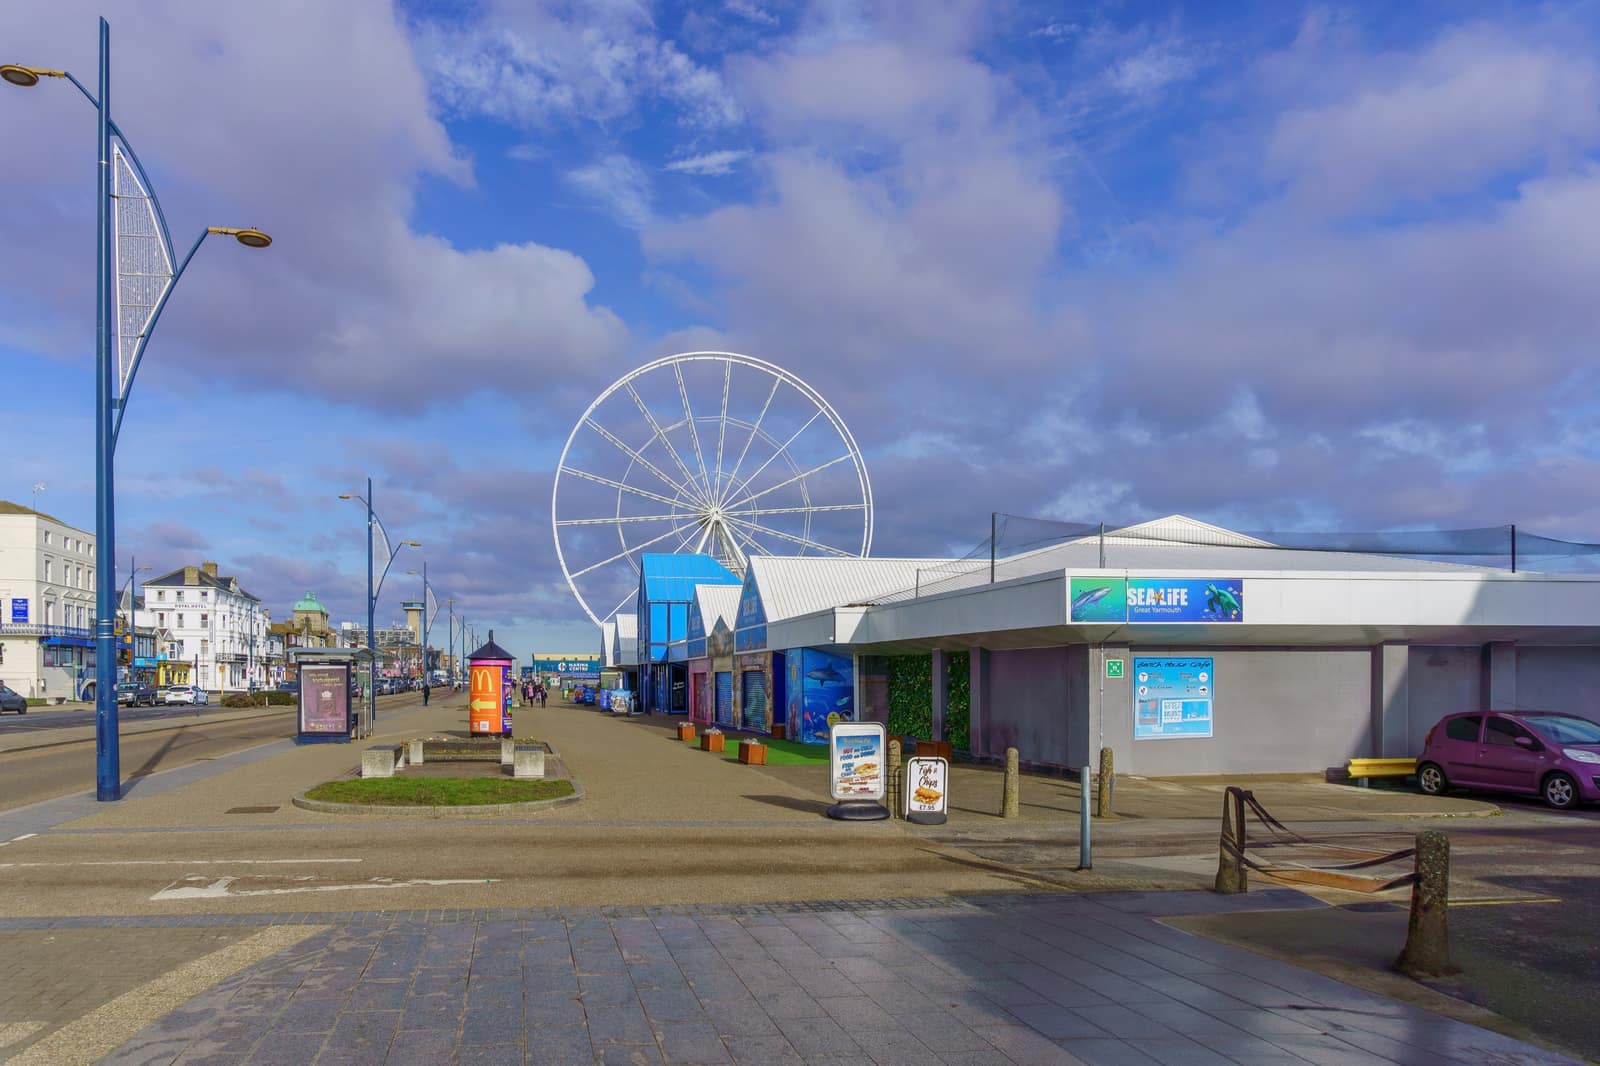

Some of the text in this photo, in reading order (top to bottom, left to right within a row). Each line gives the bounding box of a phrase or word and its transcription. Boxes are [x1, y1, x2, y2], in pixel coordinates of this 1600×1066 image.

[1127, 588, 1156, 606] SEA
[918, 764, 932, 776] Fish
[918, 775, 938, 788] Chips
